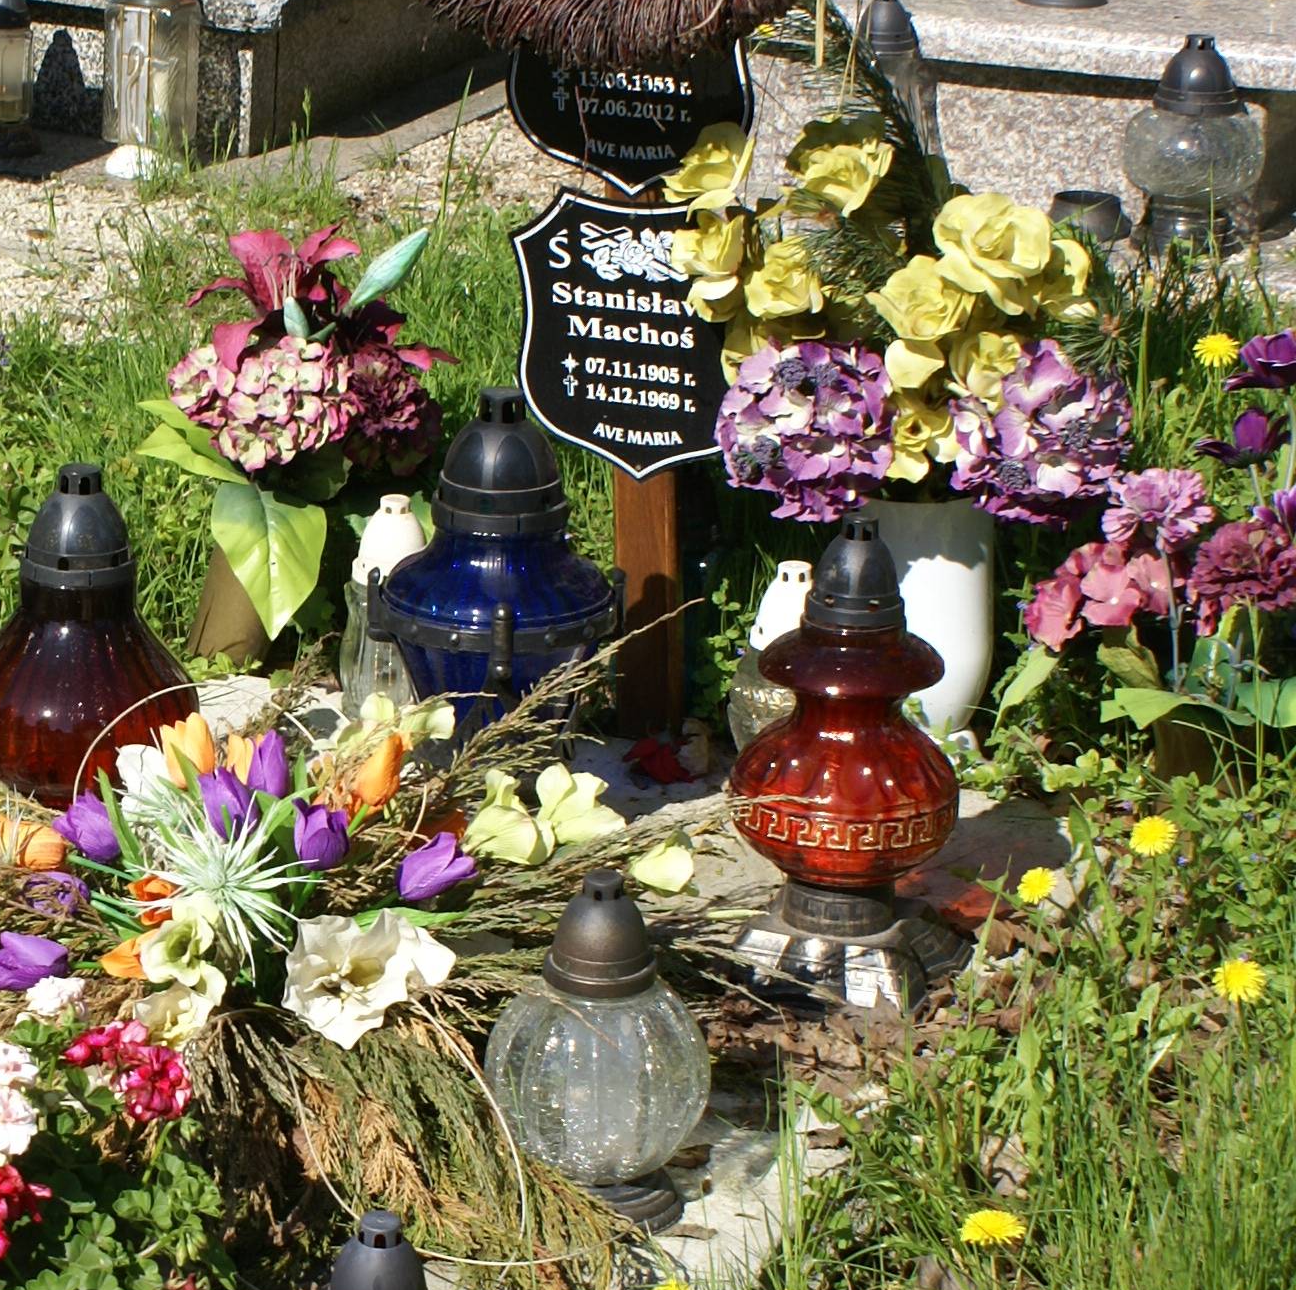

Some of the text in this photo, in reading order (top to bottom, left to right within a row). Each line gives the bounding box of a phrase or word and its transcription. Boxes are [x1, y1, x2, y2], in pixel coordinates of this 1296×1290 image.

[678, 79, 693, 96] r.
[579, 96, 693, 124] 07.06.2012 r.
[585, 138, 677, 161] AVE MARIA
[547, 228, 572, 270] Ś
[567, 314, 695, 350] Machoś
[584, 356, 697, 388] 07.11.1905 r.
[585, 383, 697, 414] 14.12.1969 r.
[592, 422, 684, 447] AVE MARIA
